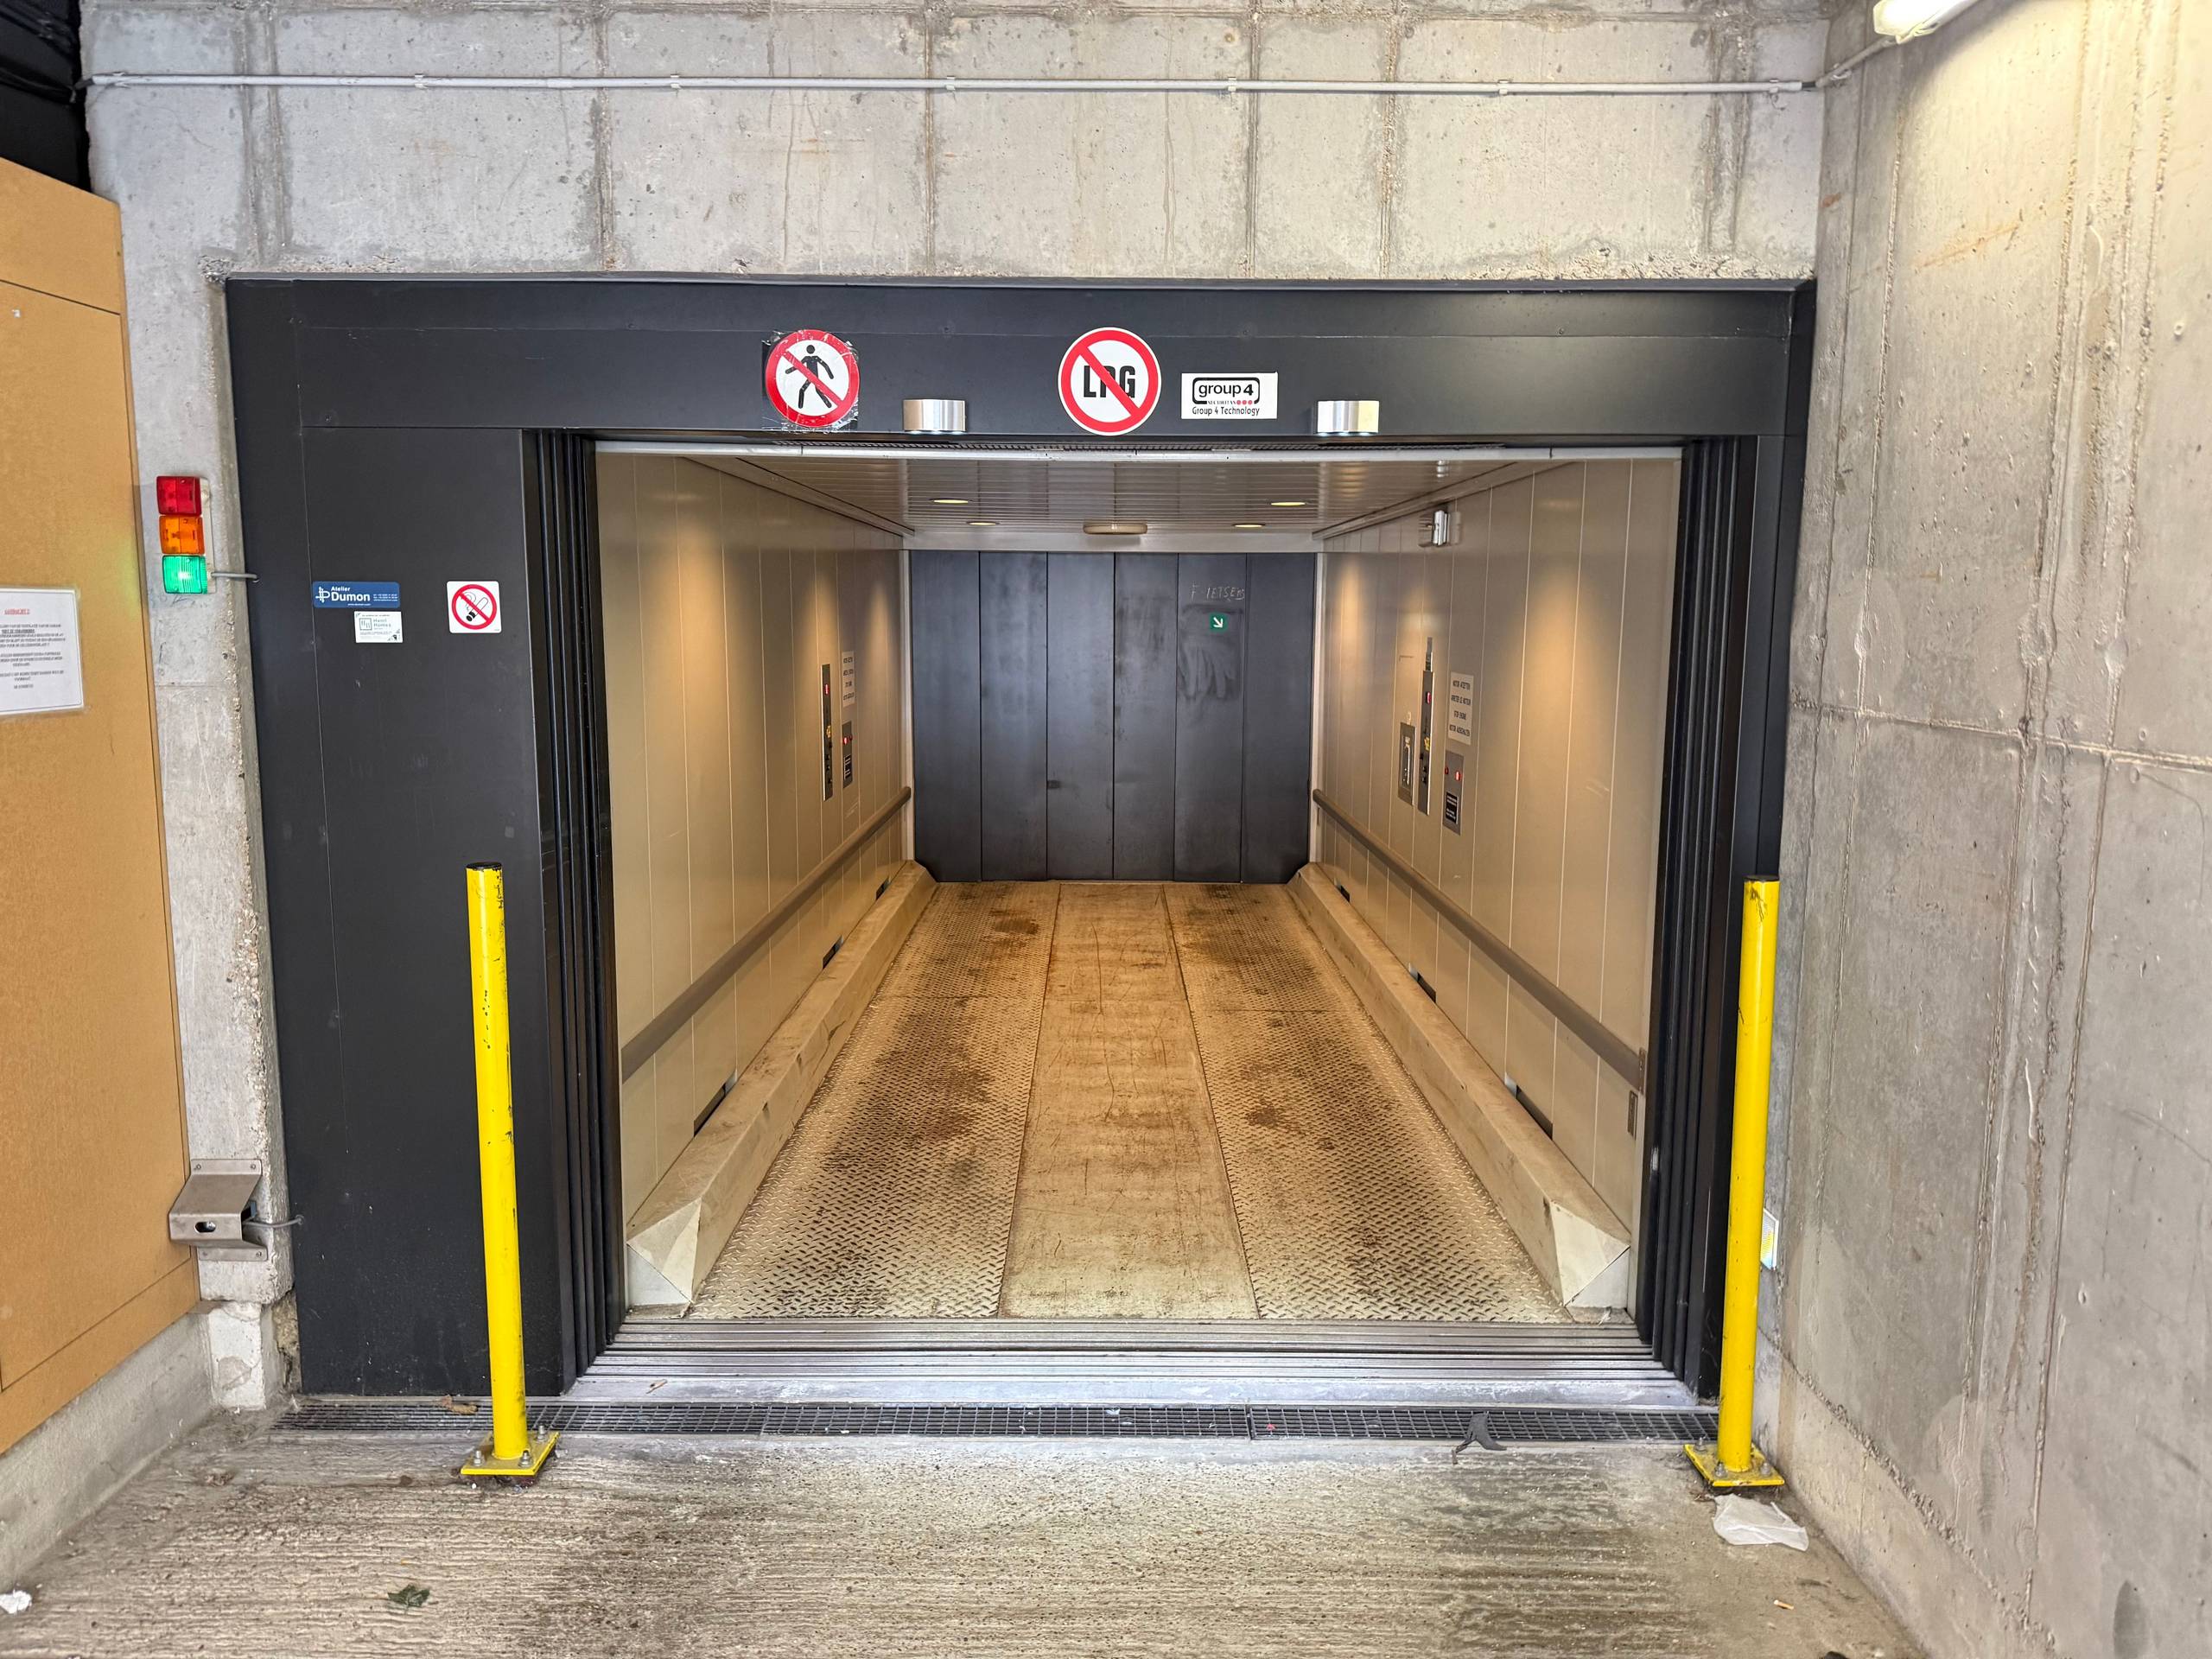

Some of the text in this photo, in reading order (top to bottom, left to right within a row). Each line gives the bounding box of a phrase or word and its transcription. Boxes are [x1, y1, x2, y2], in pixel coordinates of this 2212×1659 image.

[1192, 406, 1261, 416] Group 4 Technology
[331, 591, 371, 601] Dumon
